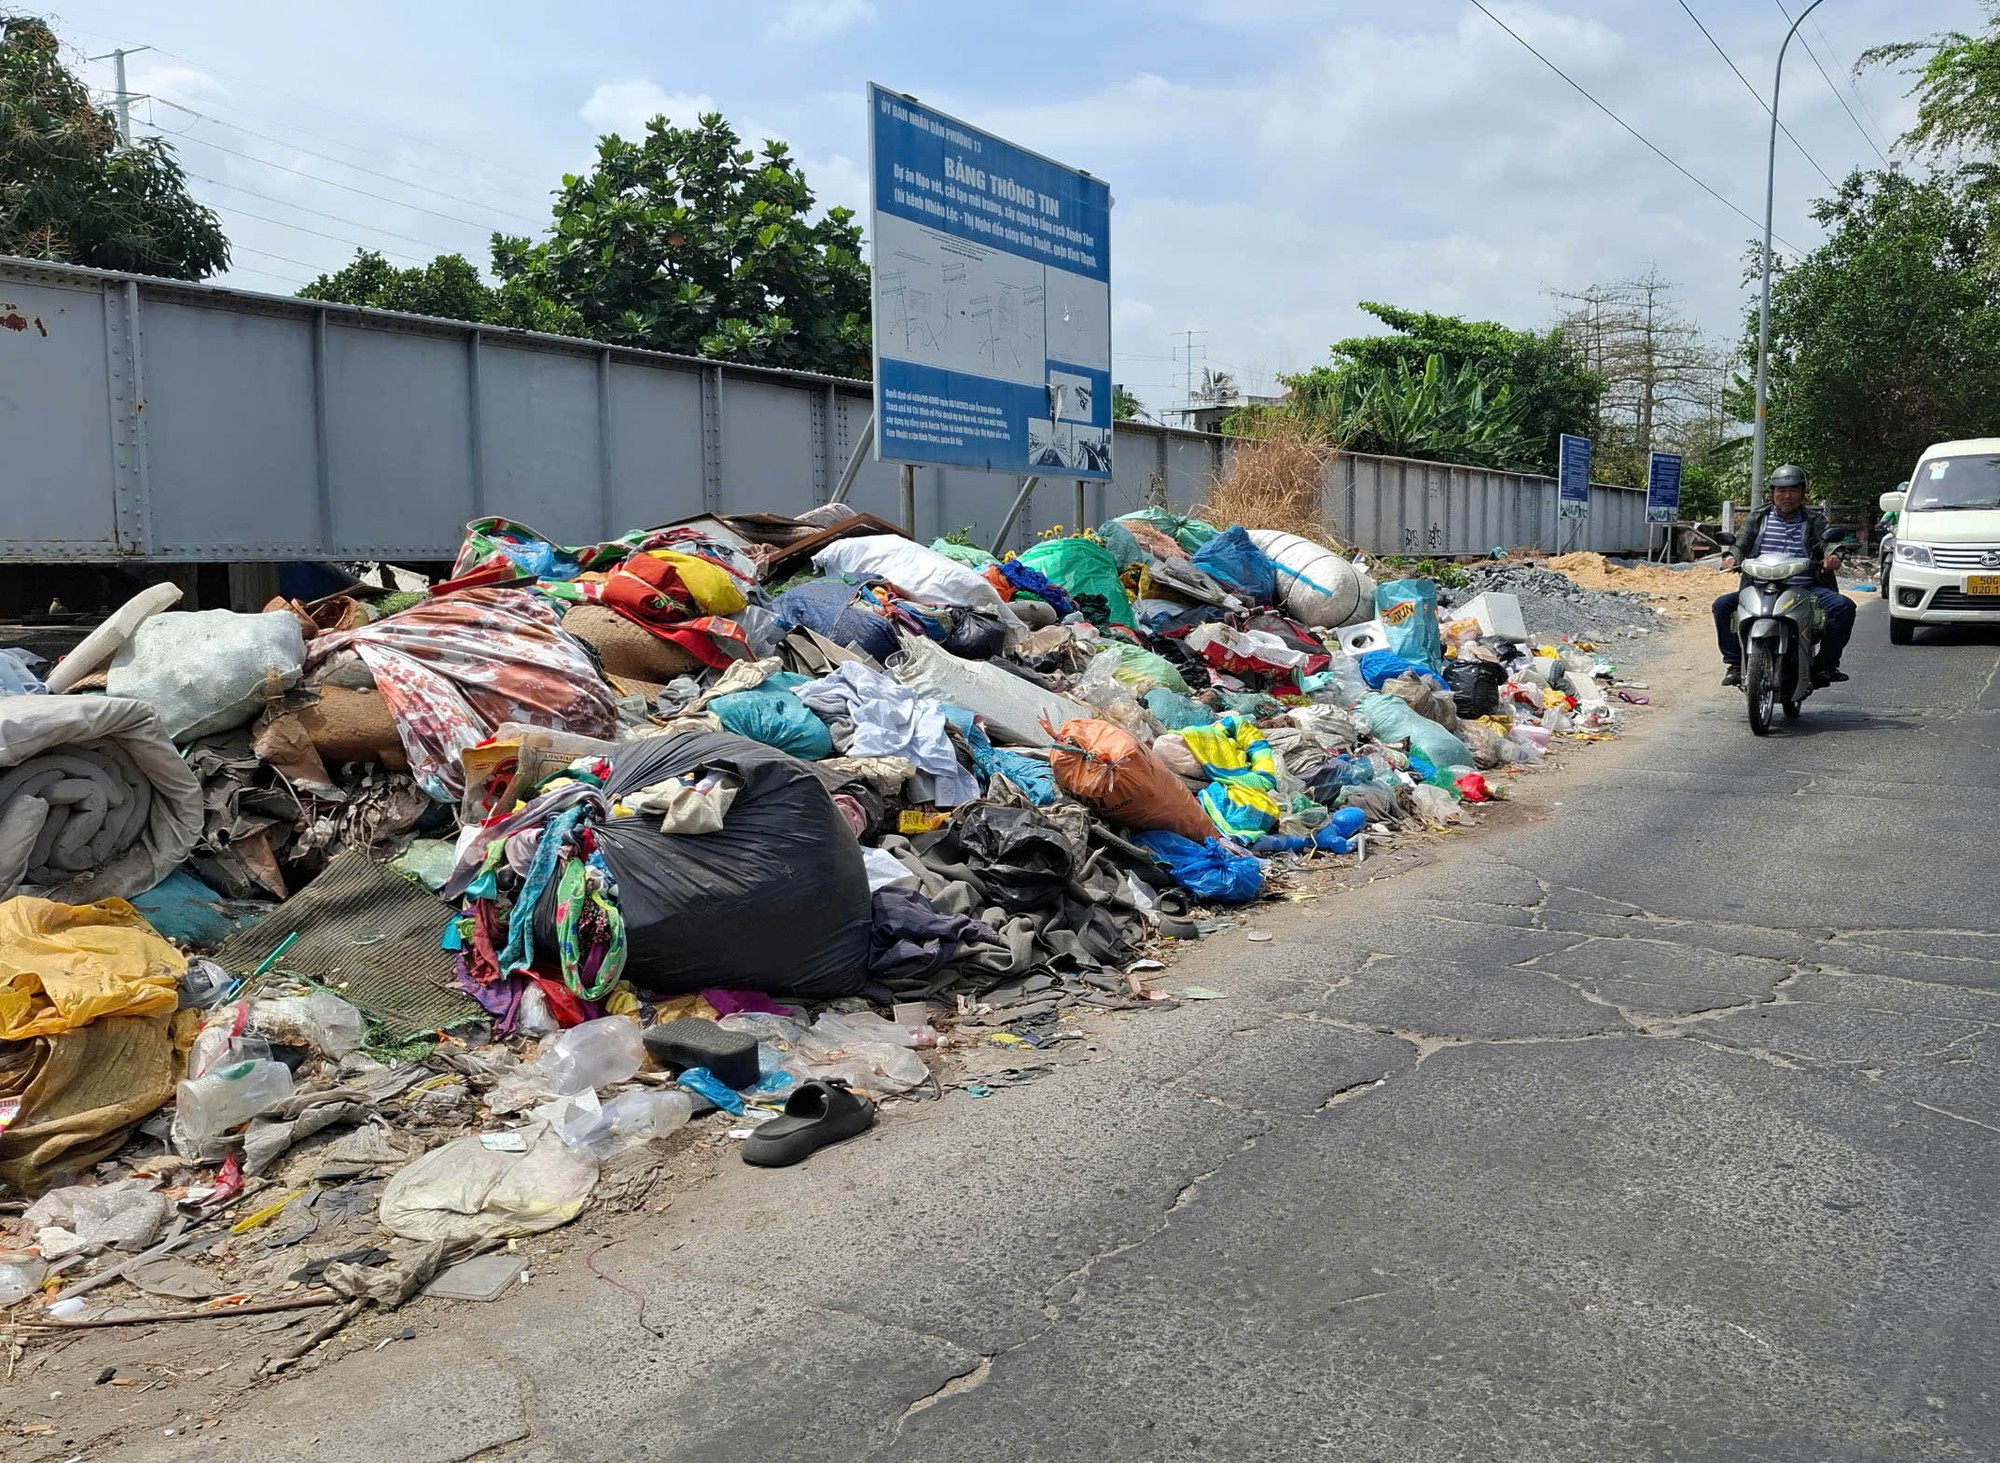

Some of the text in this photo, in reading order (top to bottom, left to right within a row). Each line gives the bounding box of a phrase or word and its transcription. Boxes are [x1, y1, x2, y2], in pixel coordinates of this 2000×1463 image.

[892, 104, 908, 122] BAN
[973, 140, 982, 154] 13
[905, 167, 915, 184] án
[944, 155, 1060, 218] BẢNG THÔNG TIN
